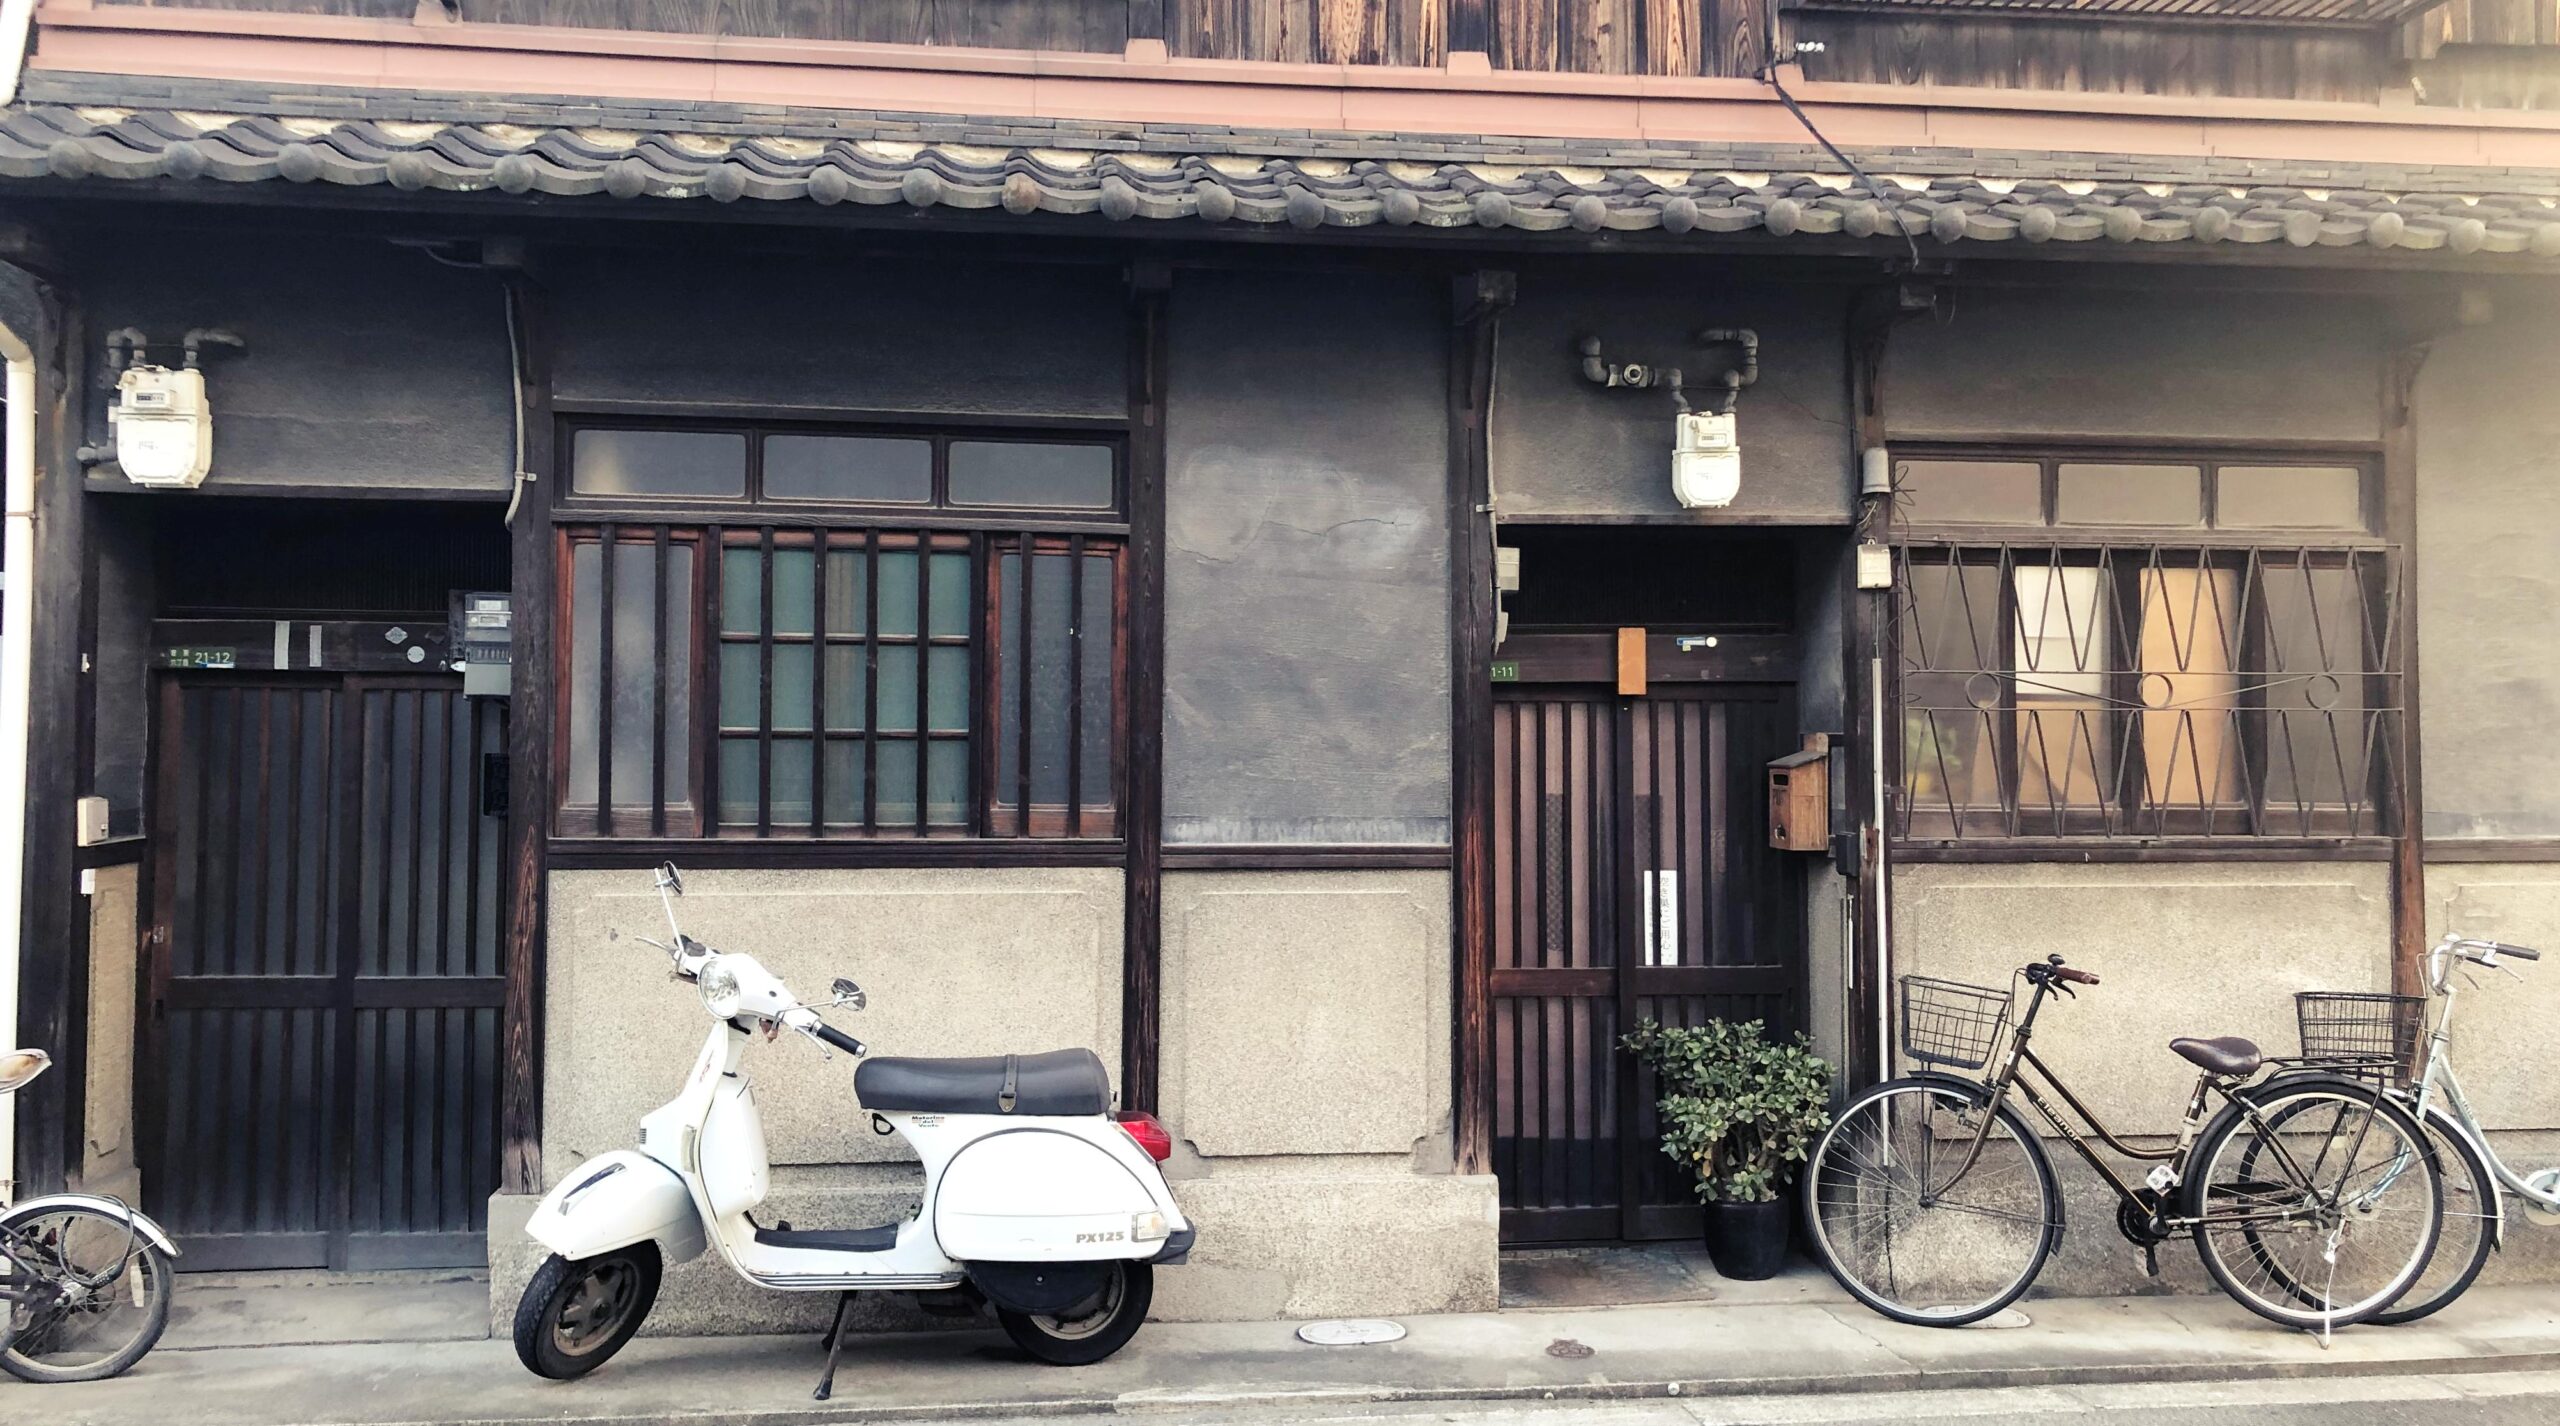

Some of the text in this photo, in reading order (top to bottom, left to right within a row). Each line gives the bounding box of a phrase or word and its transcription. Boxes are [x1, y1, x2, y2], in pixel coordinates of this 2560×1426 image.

[195, 652, 230, 664] 21-12
[2038, 1097, 2079, 1142] Eleanor
[1076, 1231, 1124, 1243] PX125
